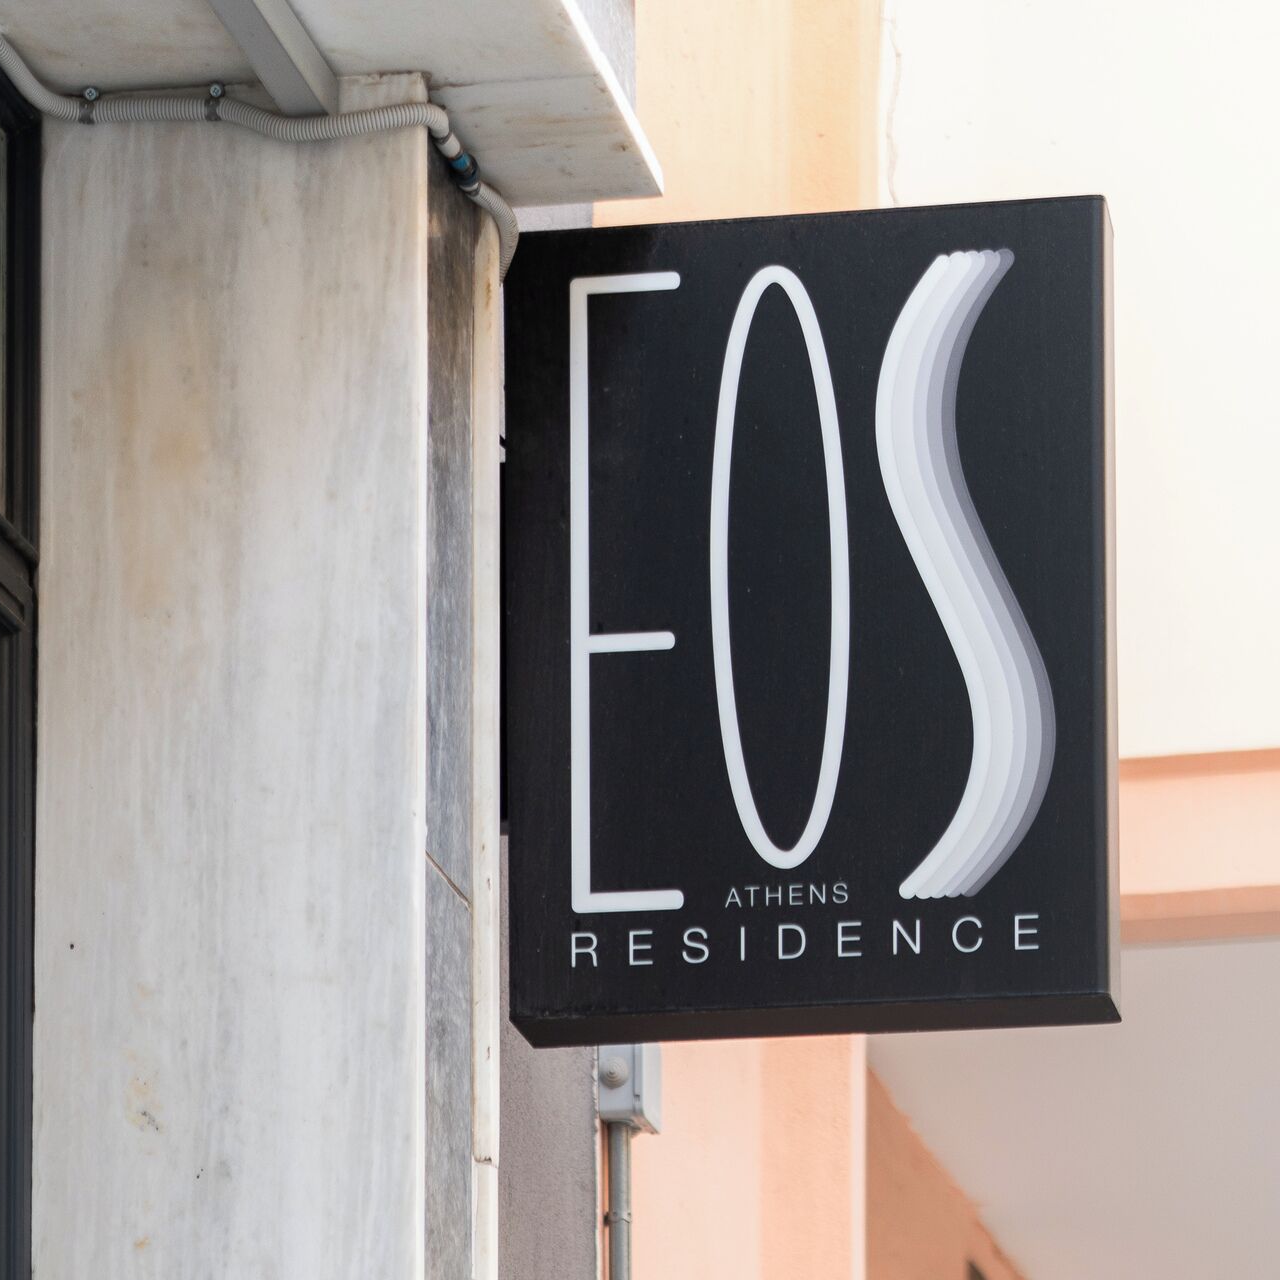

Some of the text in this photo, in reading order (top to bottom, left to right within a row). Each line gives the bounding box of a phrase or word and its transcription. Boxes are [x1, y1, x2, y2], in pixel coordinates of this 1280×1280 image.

[570, 249, 1057, 913] EOS
[724, 882, 850, 908] ATHENS
[571, 914, 1041, 968] RESIDENCE
